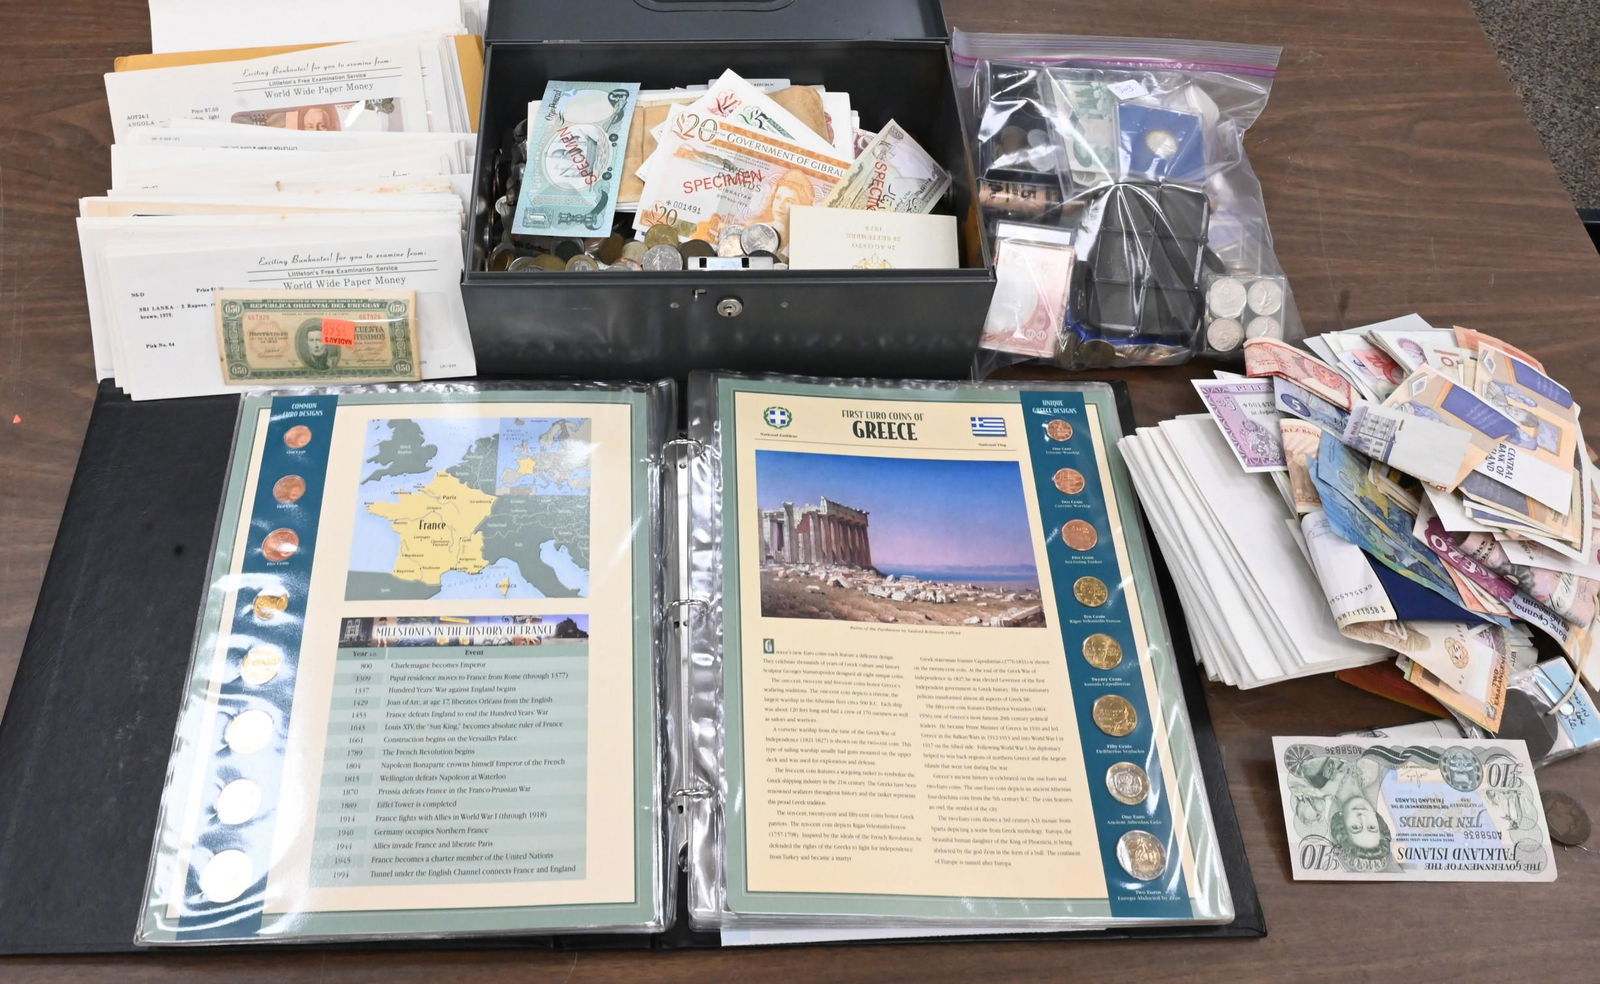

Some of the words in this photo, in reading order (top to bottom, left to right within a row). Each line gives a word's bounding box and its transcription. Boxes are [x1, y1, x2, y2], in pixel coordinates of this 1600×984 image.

[264, 88, 290, 97] World
[293, 87, 315, 95] Wide
[318, 86, 342, 94] Paper
[557, 126, 597, 186] SPECIMEN
[726, 132, 794, 160] GOVERNMENT
[796, 153, 809, 165] OF
[811, 158, 845, 176] GIBRAL
[683, 169, 765, 195] SPECIMEN
[866, 162, 888, 211] SPECIM
[258, 256, 287, 265] Exciting
[291, 253, 332, 263] Banknotes!
[335, 252, 346, 262] for
[283, 281, 312, 289] World
[315, 279, 340, 287] Wide
[343, 278, 371, 287] Paper
[375, 276, 405, 284] Money
[355, 325, 385, 333] CUENTA
[841, 409, 862, 417] FIRST
[865, 411, 886, 419] EURO
[888, 412, 911, 420] COINS
[853, 421, 918, 441] GREECE
[1499, 442, 1508, 463] BANK
[1506, 447, 1517, 480] CENTRAL
[1496, 465, 1504, 478] OF
[419, 519, 446, 530] France
[376, 627, 431, 636] MILESTONES
[434, 627, 443, 635] IN
[447, 626, 461, 635] THE
[465, 626, 502, 635] HISTORY
[506, 626, 515, 634] OF
[520, 626, 555, 635] FRANCE
[1550, 622, 1568, 642] Banc
[1492, 668, 1500, 683] TWO
[1488, 763, 1523, 788] £10
[1399, 815, 1454, 828] POUNDS
[1456, 808, 1487, 828] TEN
[1463, 830, 1502, 839] A058836
[1300, 843, 1342, 872] £10
[1397, 846, 1448, 860] ISLANDS
[1452, 841, 1520, 860] FALKLAND
[1457, 862, 1521, 870] GOVERNMENT
[1523, 862, 1540, 870] THE
